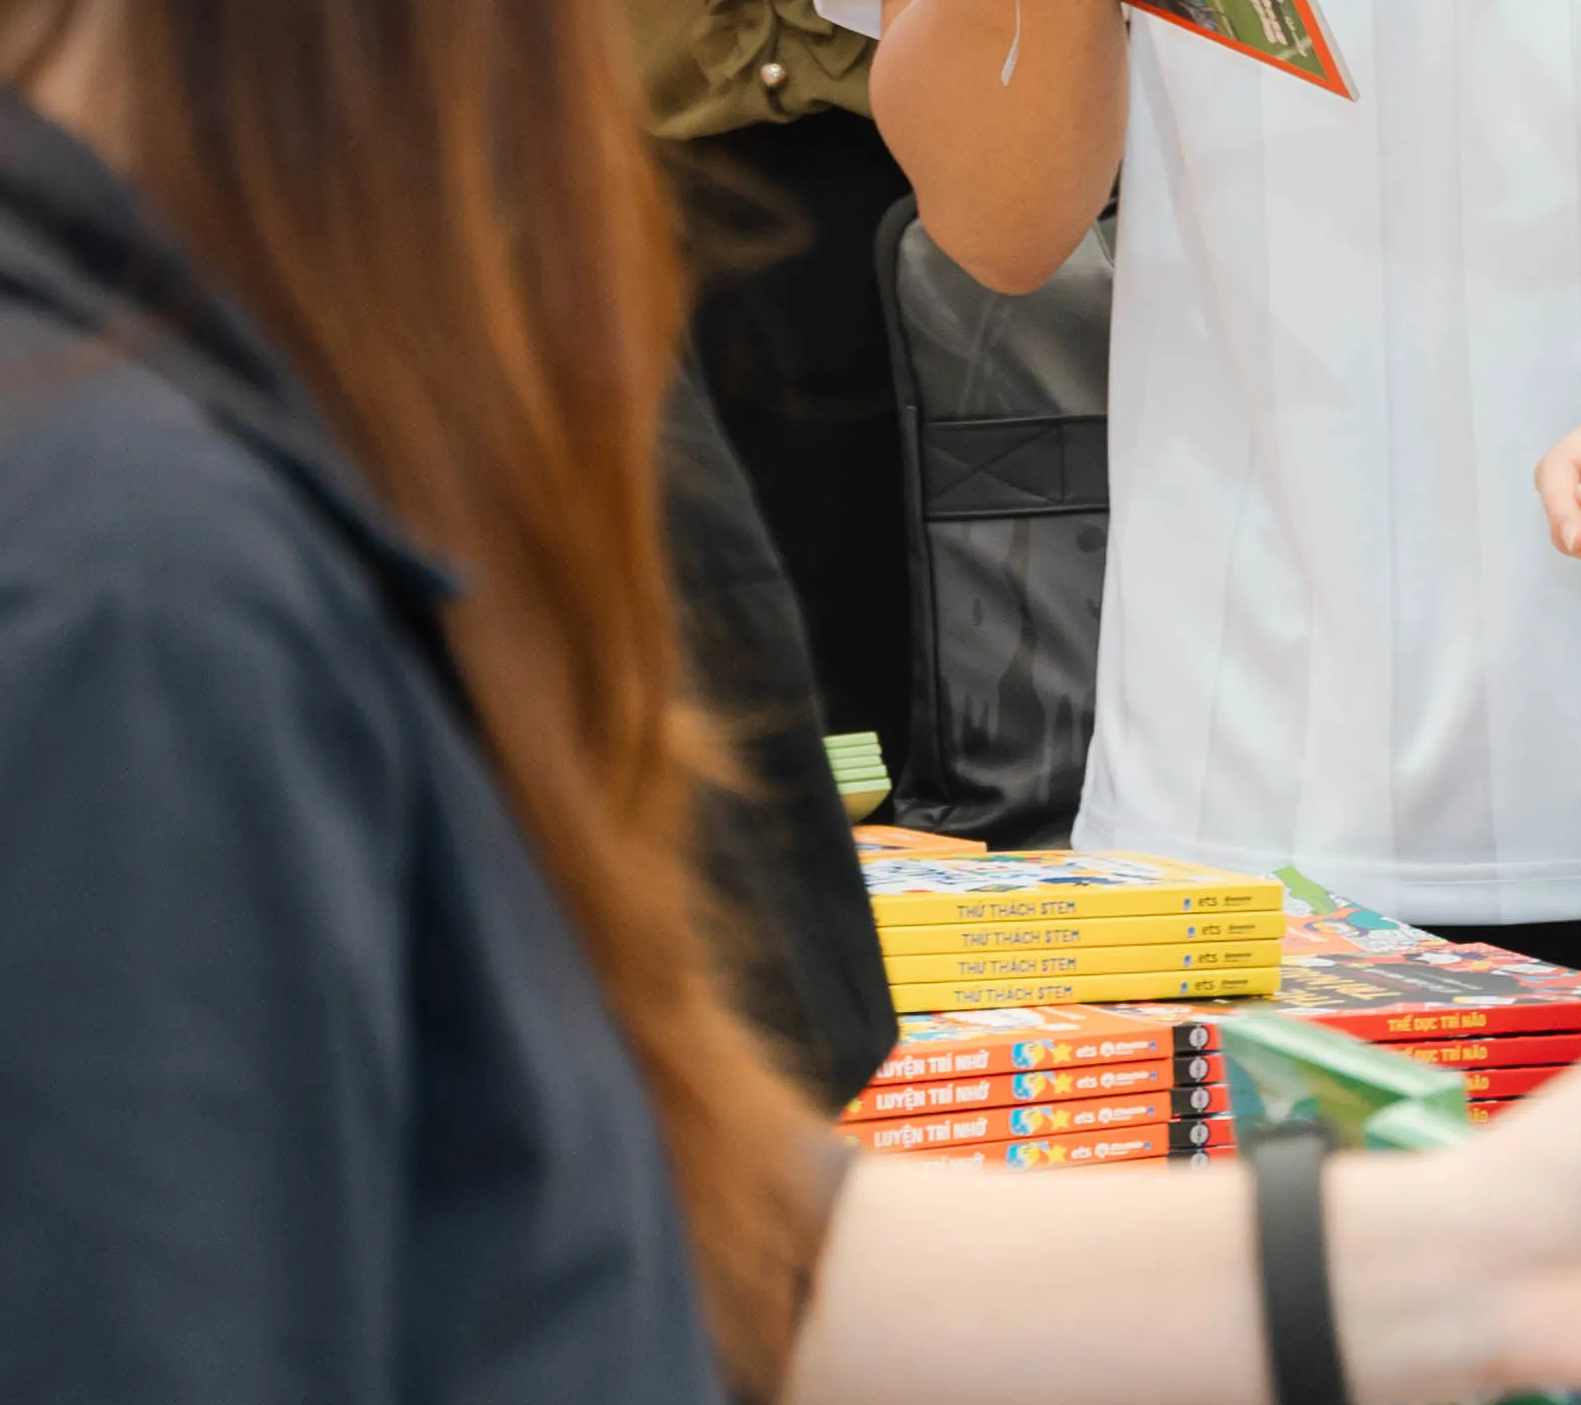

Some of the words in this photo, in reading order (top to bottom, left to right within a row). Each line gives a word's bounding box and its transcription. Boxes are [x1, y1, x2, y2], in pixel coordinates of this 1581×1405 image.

[1041, 901, 1077, 915] STEM
[1045, 930, 1081, 944] STEM
[1042, 958, 1077, 971] STEM
[1038, 986, 1073, 999] STEM
[1440, 1011, 1461, 1029] TRÍ
[1461, 1011, 1487, 1028] NÃO
[1440, 1044, 1462, 1062] TRÍ
[1462, 1043, 1488, 1061] NÃO
[876, 1055, 926, 1080] LUYỆN
[927, 1052, 953, 1074] TRÍ
[955, 1049, 990, 1071] NHỚ
[876, 1087, 926, 1112] LUYỆN
[927, 1082, 953, 1105] TRÍ
[955, 1080, 991, 1103] NHỚ
[873, 1123, 924, 1148] LUYỆN
[925, 1120, 951, 1142] TRÍ
[953, 1117, 988, 1140] NHỚ
